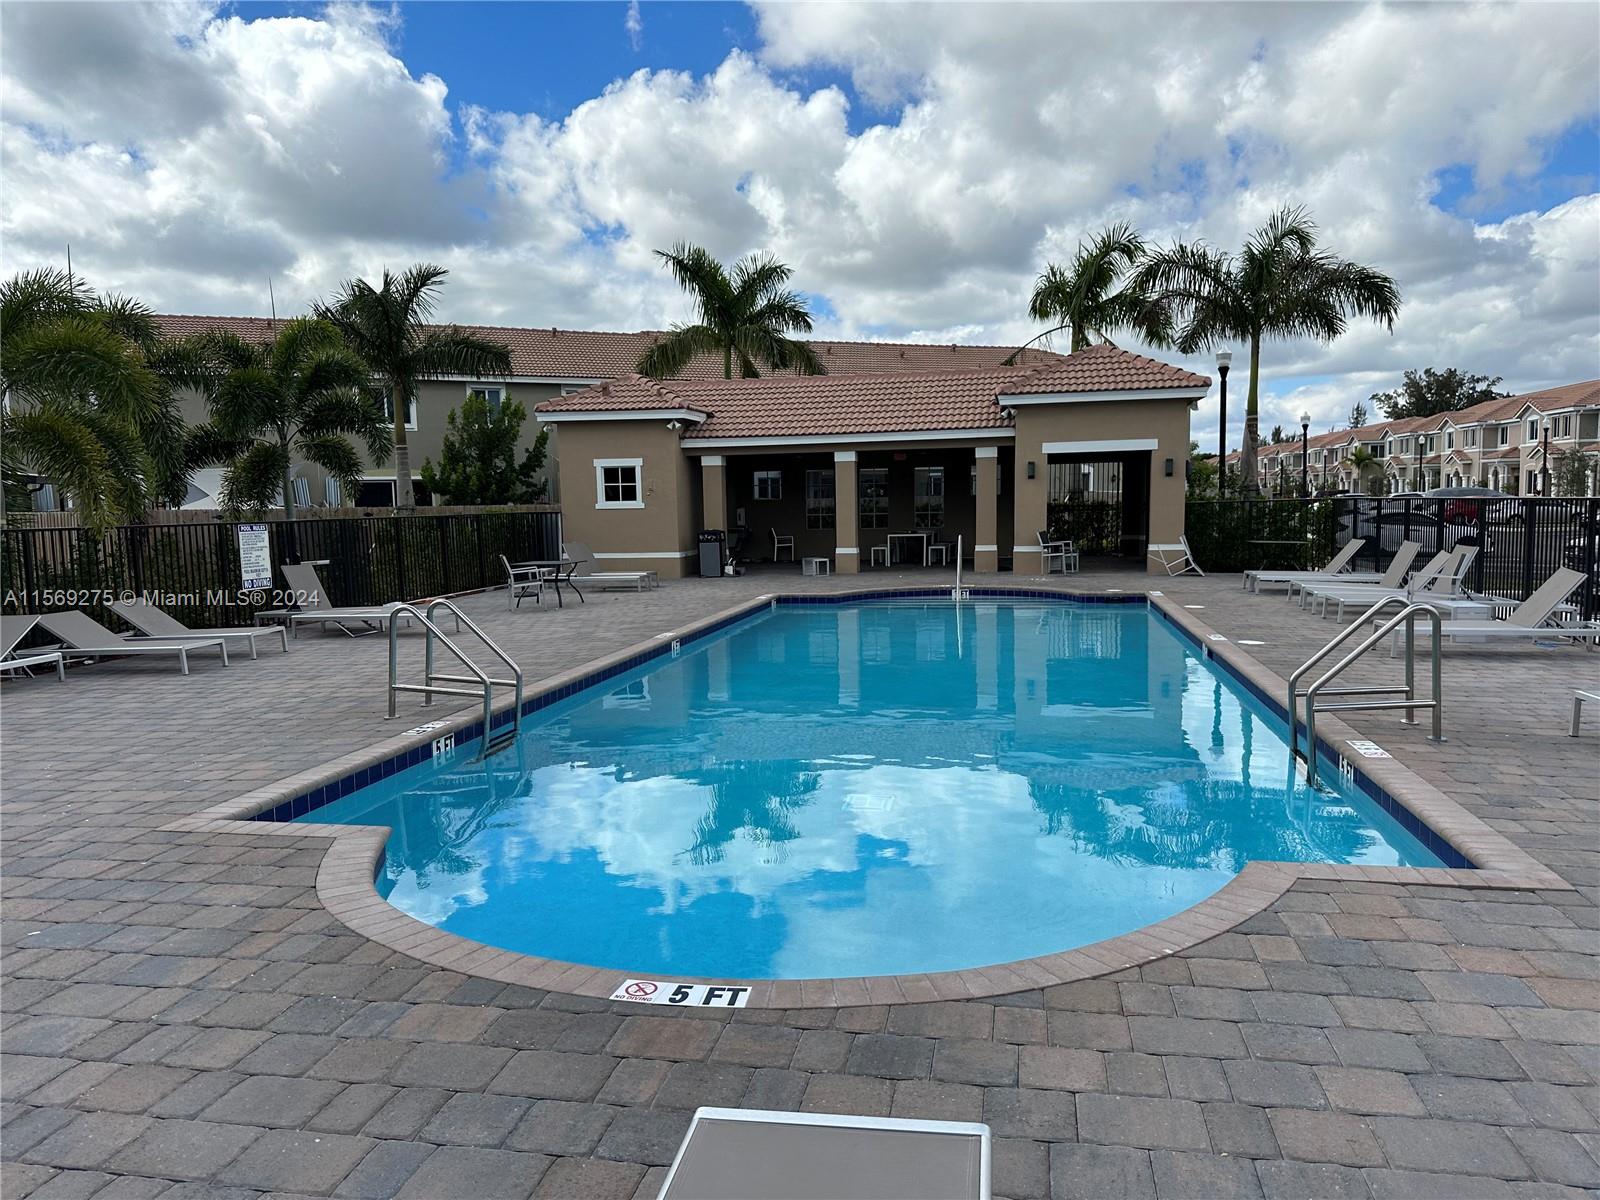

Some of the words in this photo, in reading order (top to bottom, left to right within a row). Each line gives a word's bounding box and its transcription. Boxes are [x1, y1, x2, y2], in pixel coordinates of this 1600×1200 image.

[244, 579, 252, 589] NO
[253, 578, 271, 588] DIVING
[668, 984, 694, 1004] 5
[701, 987, 748, 1006] FT
